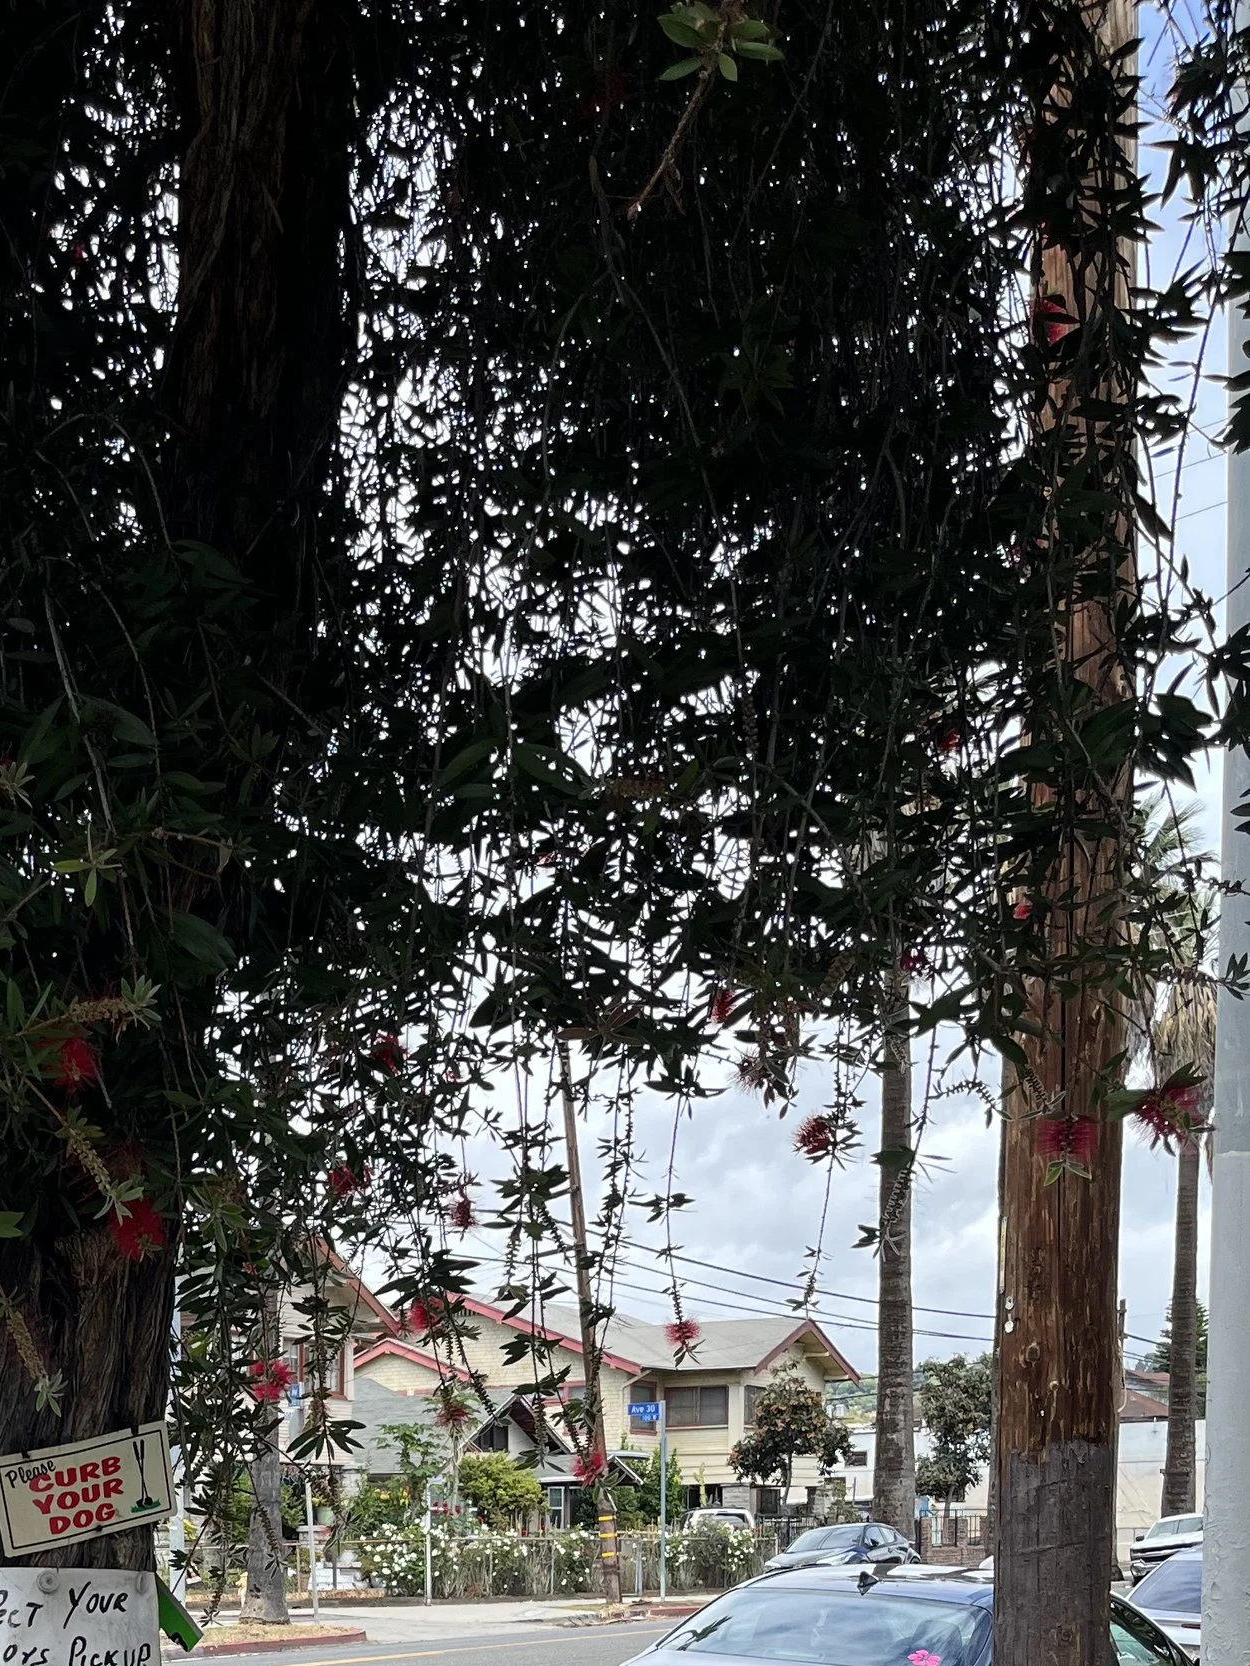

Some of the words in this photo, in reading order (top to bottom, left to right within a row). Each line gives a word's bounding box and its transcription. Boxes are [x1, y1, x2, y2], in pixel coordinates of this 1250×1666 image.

[631, 1405, 645, 1413] Ave
[646, 1404, 656, 1413] 30
[5, 1460, 56, 1488] Please
[29, 1456, 121, 1492] CURB
[33, 1478, 124, 1515] YOUR
[49, 1503, 116, 1534] DOG
